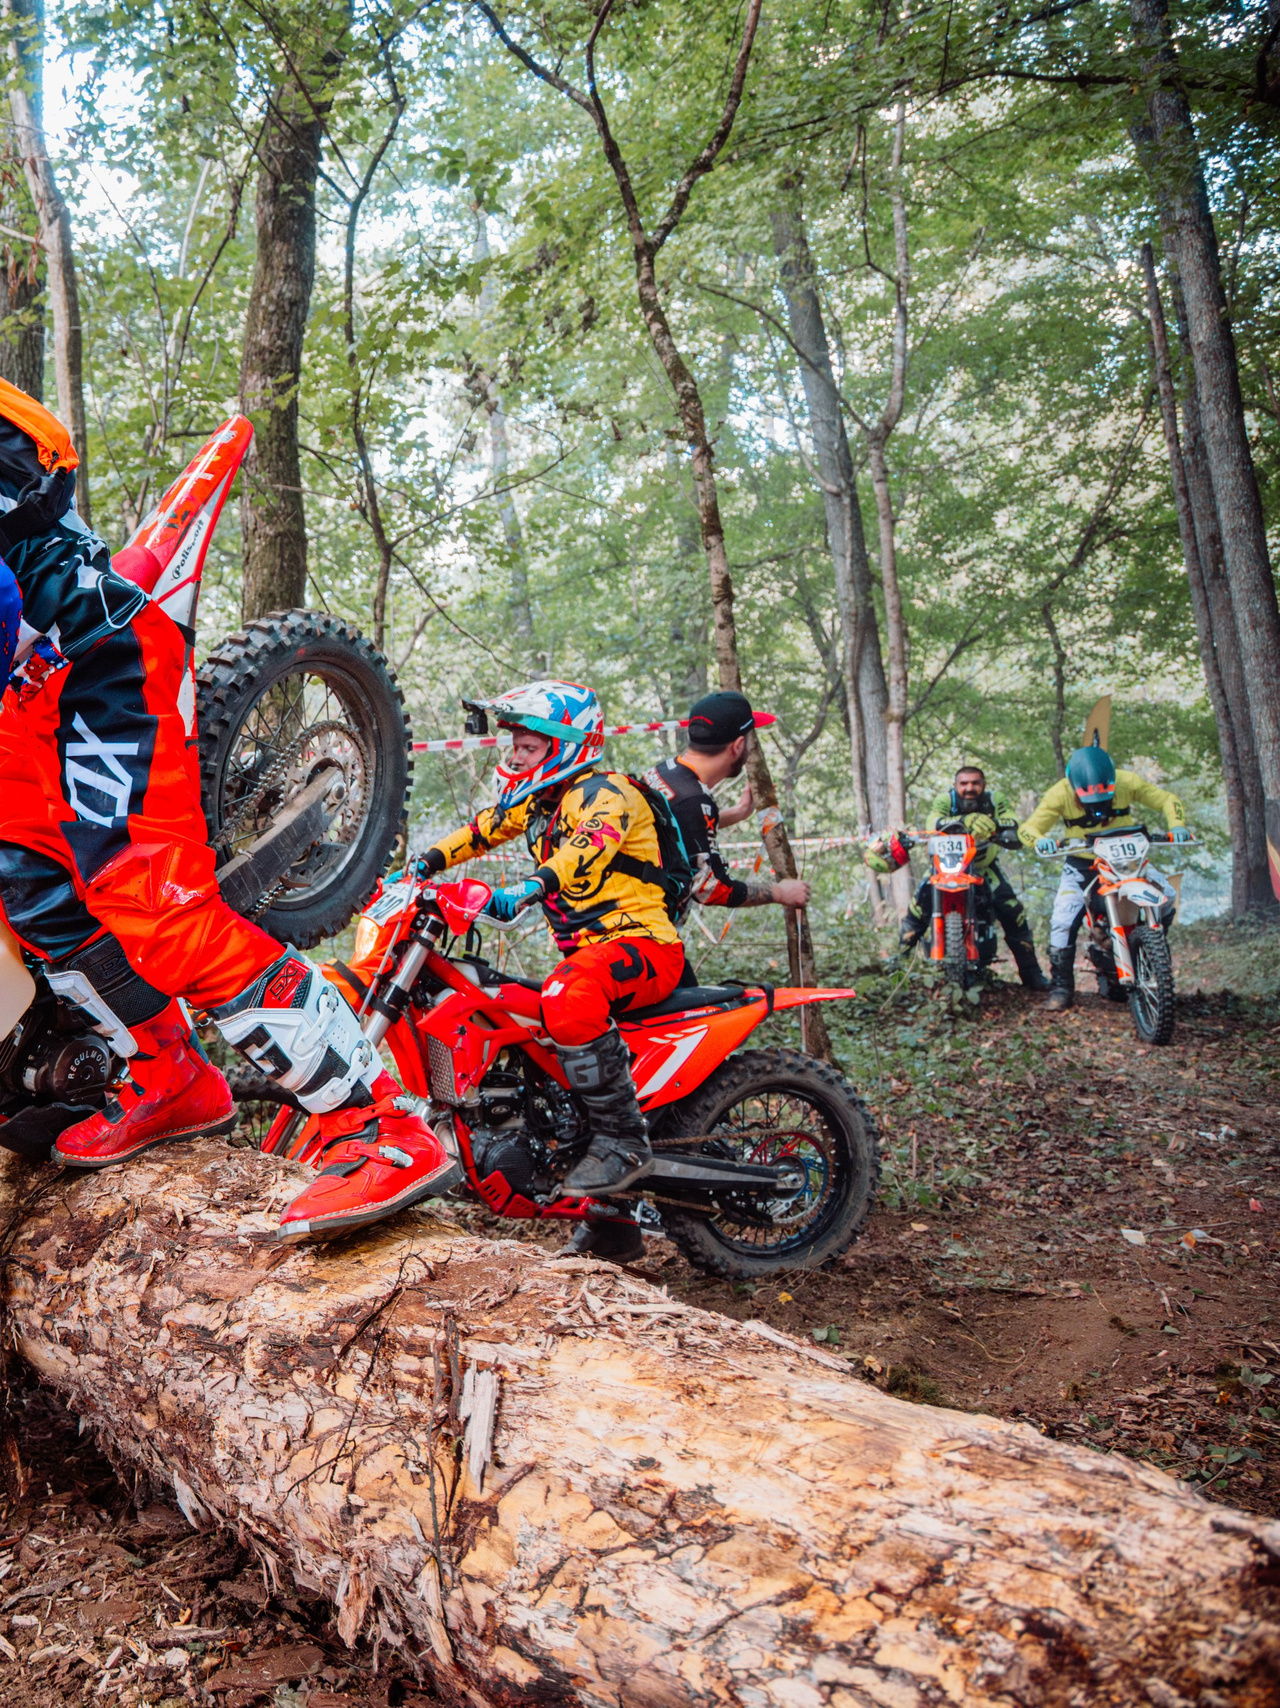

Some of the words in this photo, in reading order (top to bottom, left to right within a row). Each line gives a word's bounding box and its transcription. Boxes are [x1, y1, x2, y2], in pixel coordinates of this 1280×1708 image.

[938, 840, 963, 853] 534
[1110, 843, 1137, 857] 519
[67, 1050, 107, 1080] REGULMOTO
